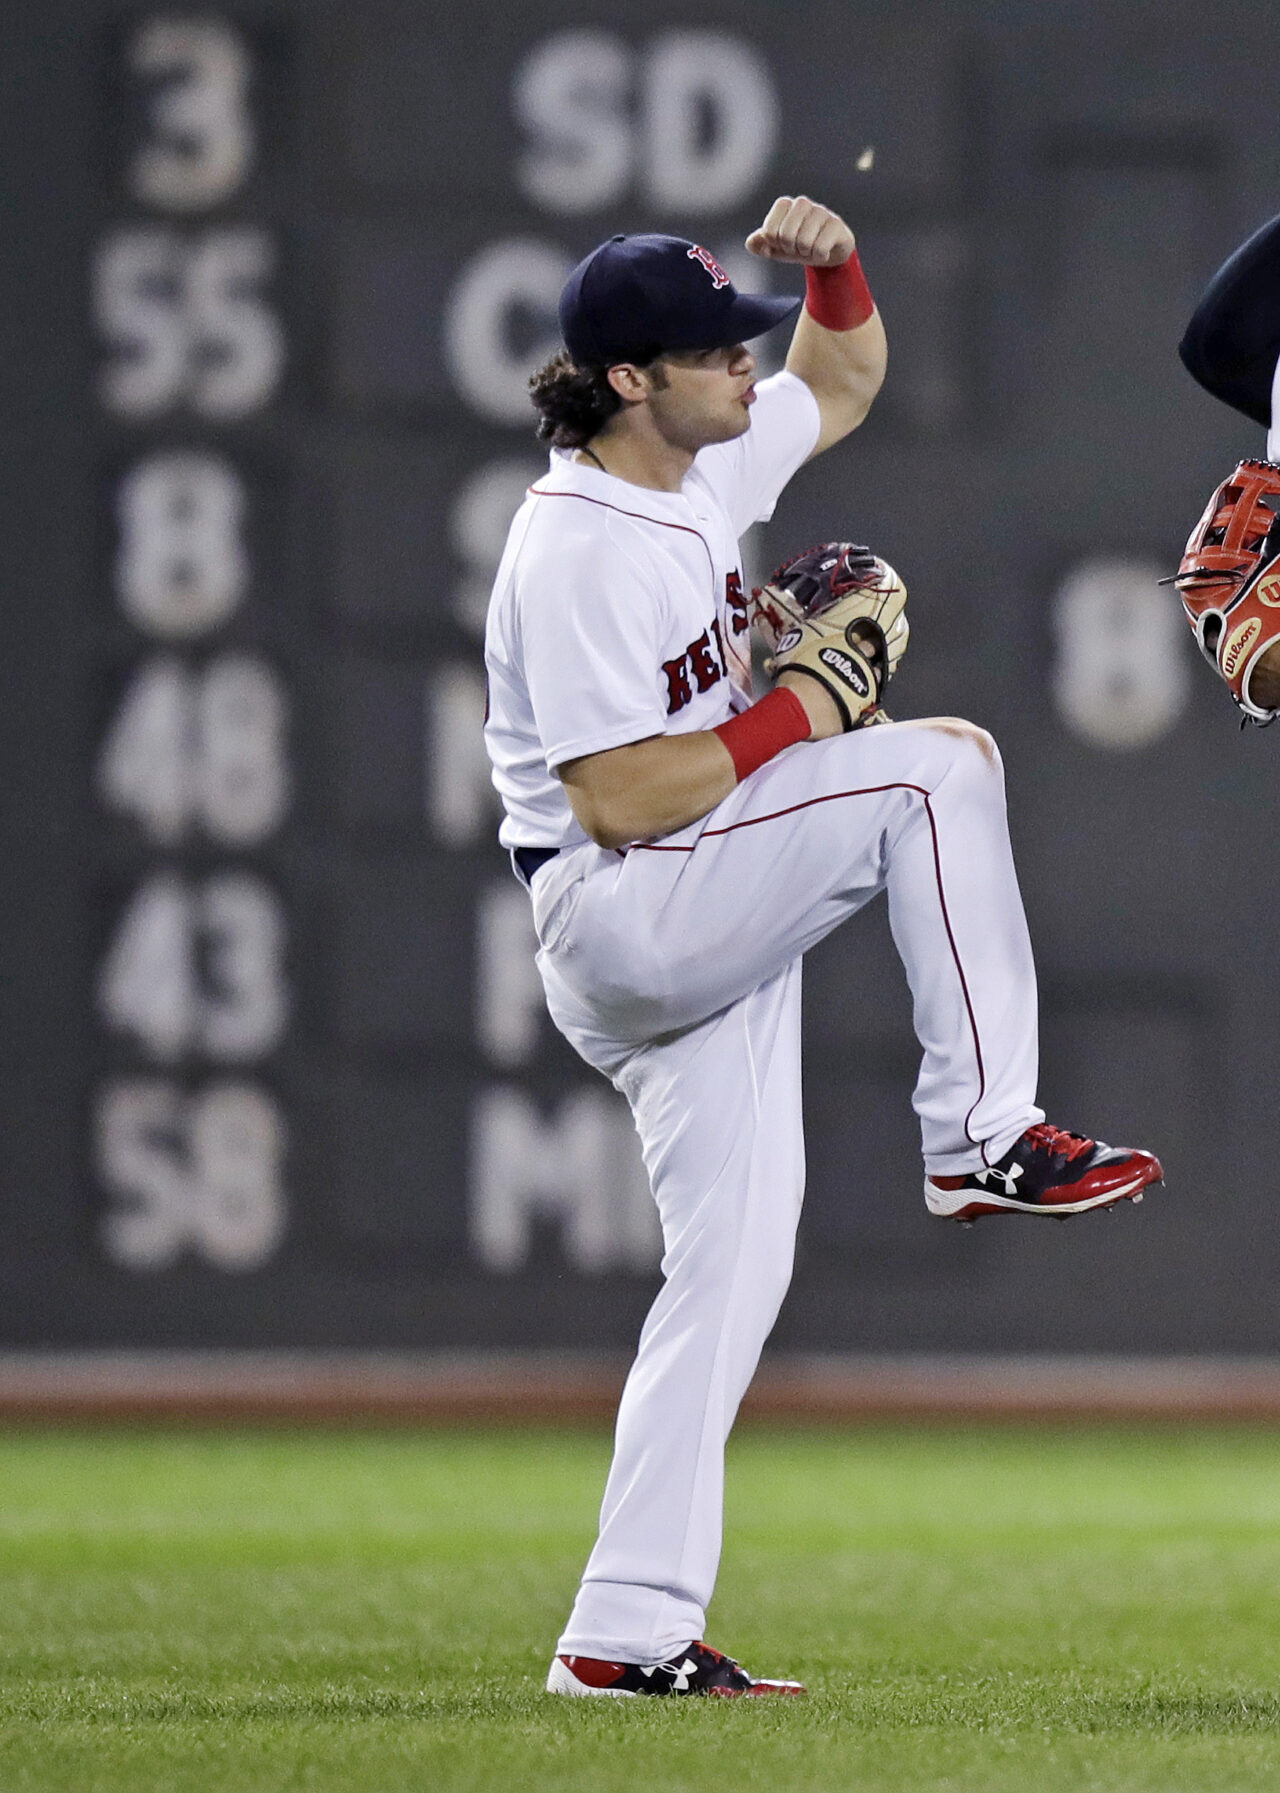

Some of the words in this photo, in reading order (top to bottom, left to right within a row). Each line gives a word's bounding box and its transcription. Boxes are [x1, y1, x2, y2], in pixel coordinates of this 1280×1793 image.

[130, 17, 253, 207] 3
[513, 28, 778, 214] SD
[95, 227, 282, 419] 55
[119, 450, 249, 639] 8
[822, 648, 865, 694] Wilson
[1051, 557, 1190, 754] 8
[1224, 624, 1257, 675] Wilson
[101, 869, 284, 1063] 43
